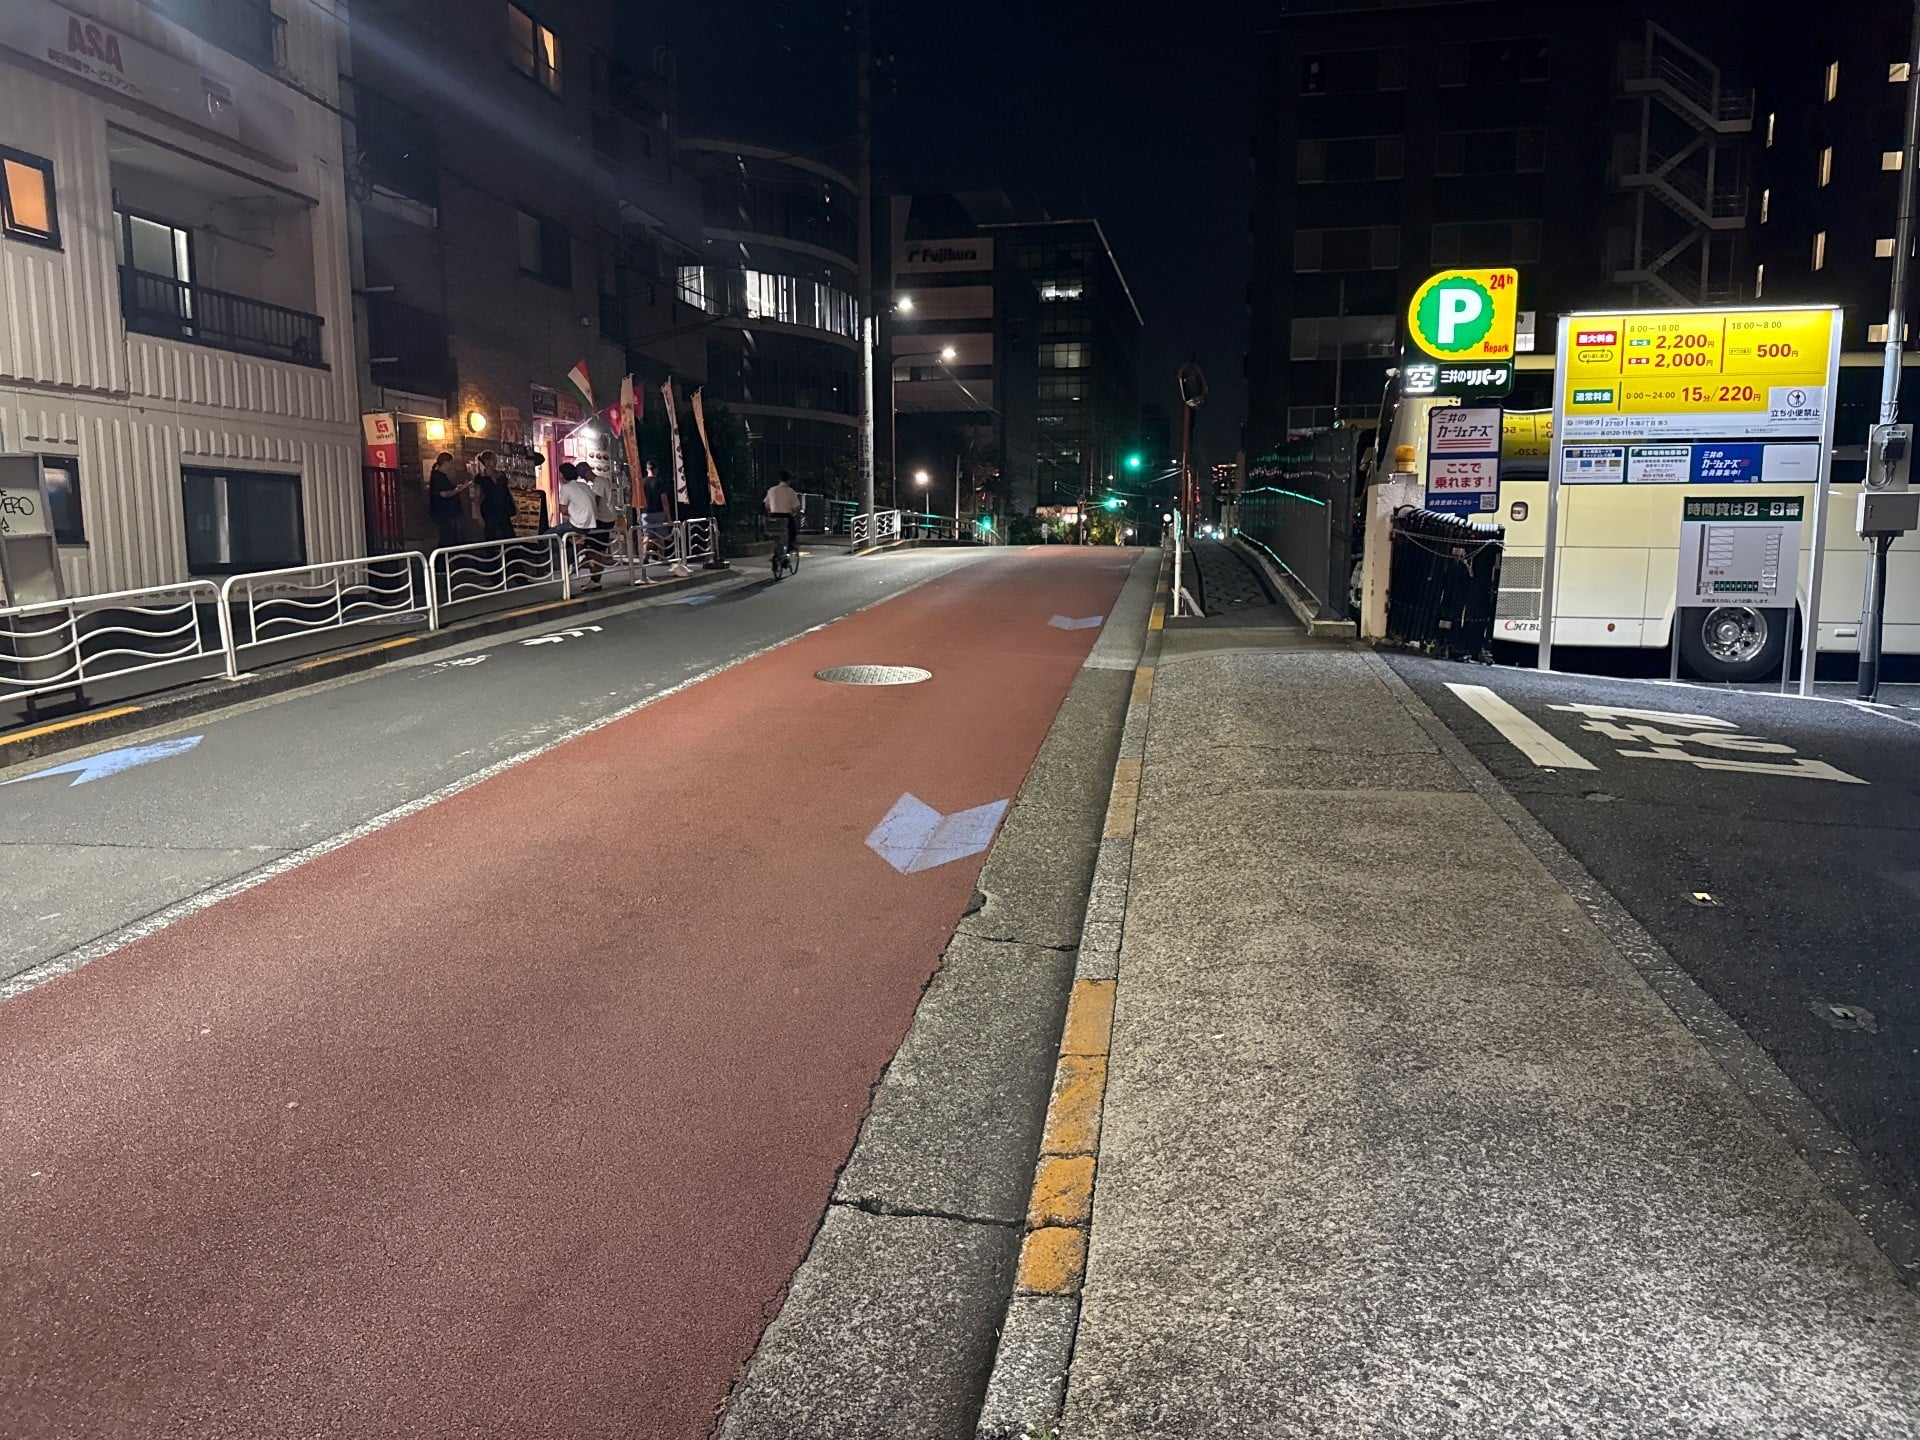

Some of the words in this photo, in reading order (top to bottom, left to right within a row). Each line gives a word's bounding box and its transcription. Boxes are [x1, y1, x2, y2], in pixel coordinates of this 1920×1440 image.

[921, 249, 977, 264] Fujikura
[1490, 274, 1513, 290] 24h
[1437, 288, 1483, 344] P
[1484, 341, 1509, 354] Repark
[1406, 365, 1436, 393] 空
[1440, 368, 1508, 386] 三井のリパーク
[1575, 392, 1611, 402] 通常料金
[1437, 413, 1467, 424] 三井の
[1770, 409, 1821, 418] 立ち小便禁止
[1437, 425, 1494, 438] カーシェアーズ
[1702, 451, 1723, 459] 三井の
[1447, 463, 1482, 474] ここで
[1435, 476, 1493, 489] 乗れます！
